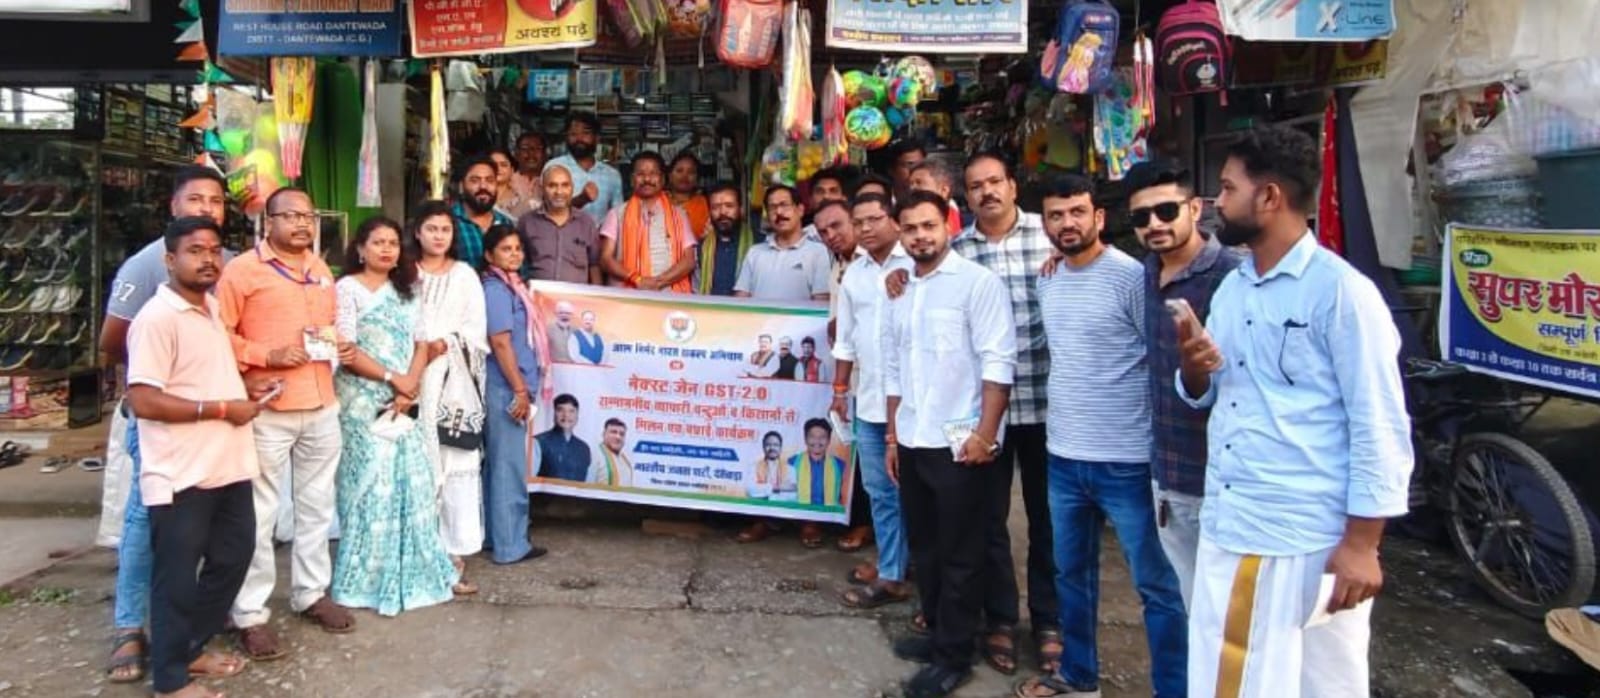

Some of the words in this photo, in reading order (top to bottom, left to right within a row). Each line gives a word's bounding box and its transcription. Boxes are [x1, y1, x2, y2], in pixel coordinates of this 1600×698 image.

[260, 22, 293, 31] HOUSE
[296, 22, 323, 31] ROAD
[325, 22, 387, 31] DANTEWADA
[516, 26, 561, 39] अवश्य
[285, 34, 344, 44] DANTEWADA
[1468, 271, 1543, 322] सुपर
[1541, 364, 1562, 377] तक
[672, 377, 698, 396] जेन
